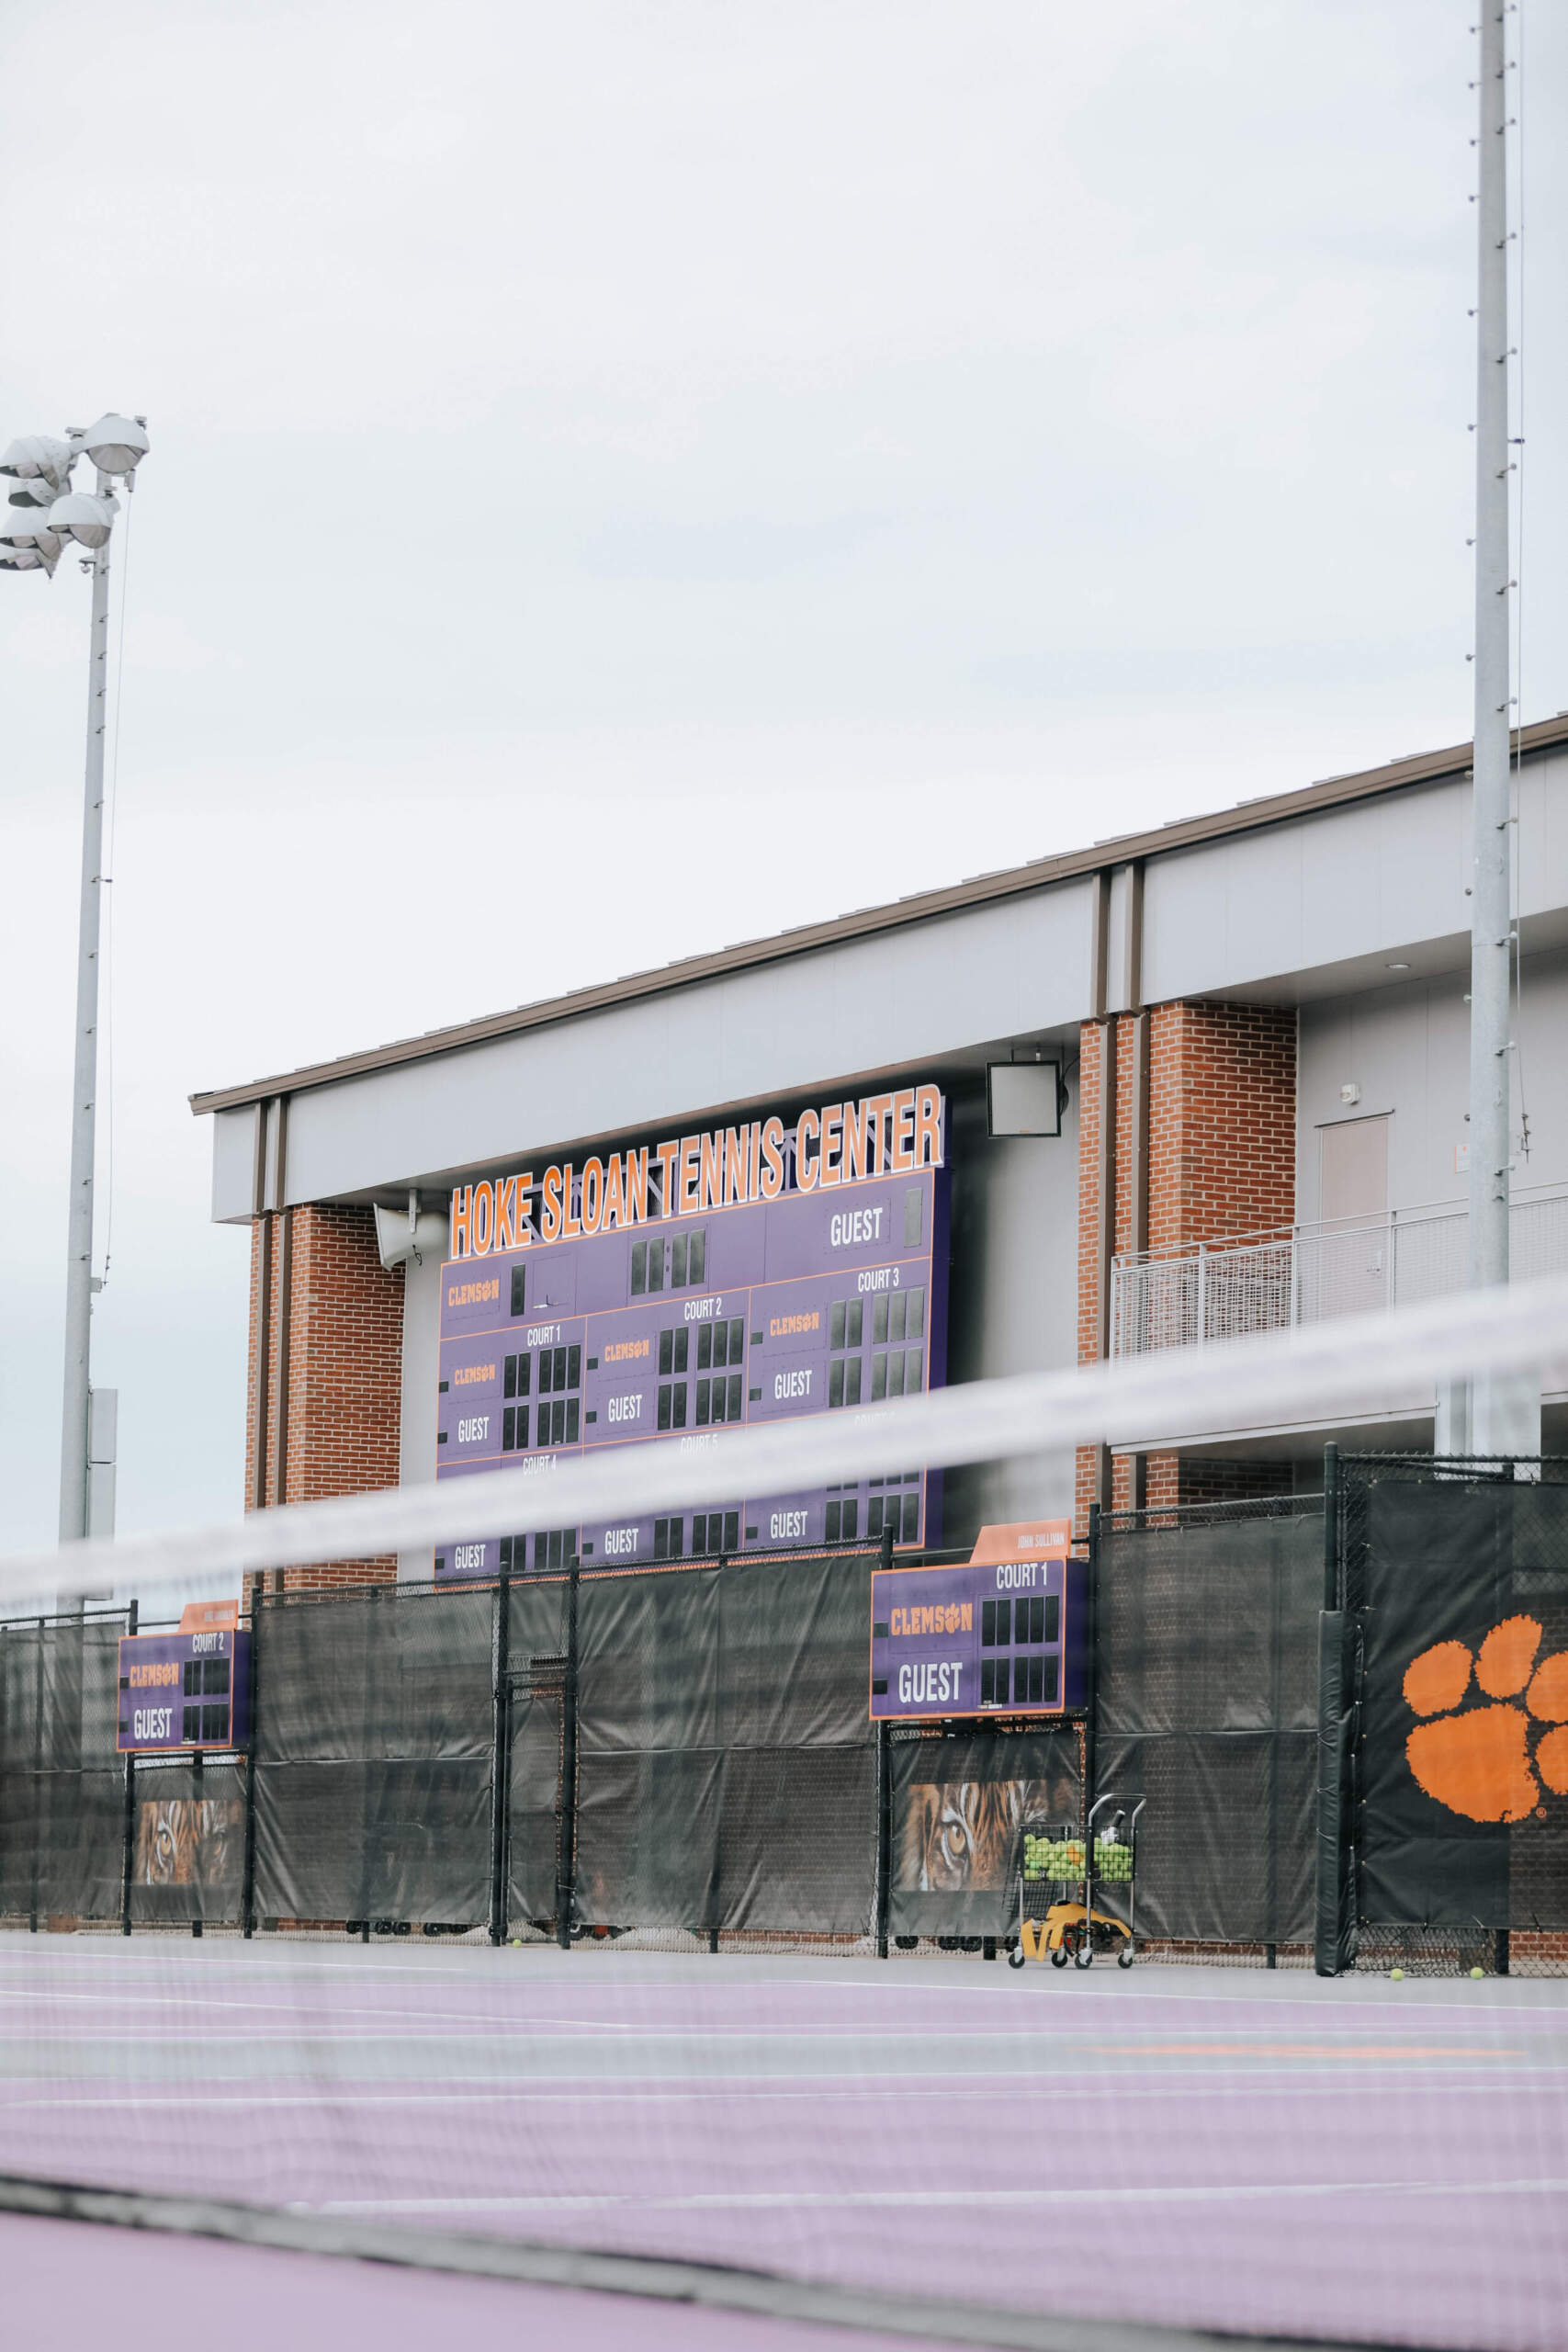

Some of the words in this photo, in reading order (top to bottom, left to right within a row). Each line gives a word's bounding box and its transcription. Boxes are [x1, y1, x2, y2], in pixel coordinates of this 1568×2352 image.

[451, 1171, 534, 1260] HOKE
[541, 1146, 649, 1243] SLOAN
[657, 1116, 784, 1219] TENNIS
[795, 1083, 943, 1193] CENTER
[830, 1207, 883, 1247] GUEST
[858, 1269, 891, 1293] COURT
[893, 1267, 899, 1287] 3
[684, 1298, 714, 1320] COURT
[716, 1296, 722, 1316] 2
[527, 1326, 554, 1347] COURT
[556, 1324, 561, 1341] 1
[774, 1370, 812, 1400] GUEST
[608, 1394, 643, 1422] GUEST
[458, 1416, 490, 1443] GUEST
[523, 1455, 550, 1476] COURT
[771, 1511, 808, 1539] GUEST
[604, 1528, 638, 1555] GUEST
[455, 1544, 486, 1569] GUEST
[996, 1562, 1038, 1589] COURT
[1041, 1561, 1047, 1587] 1
[891, 1602, 973, 1636] CLEMSON
[192, 1632, 218, 1654] COURT
[219, 1631, 224, 1651] 2
[898, 1662, 963, 1703] GUEST
[134, 1707, 173, 1740] GUEST
